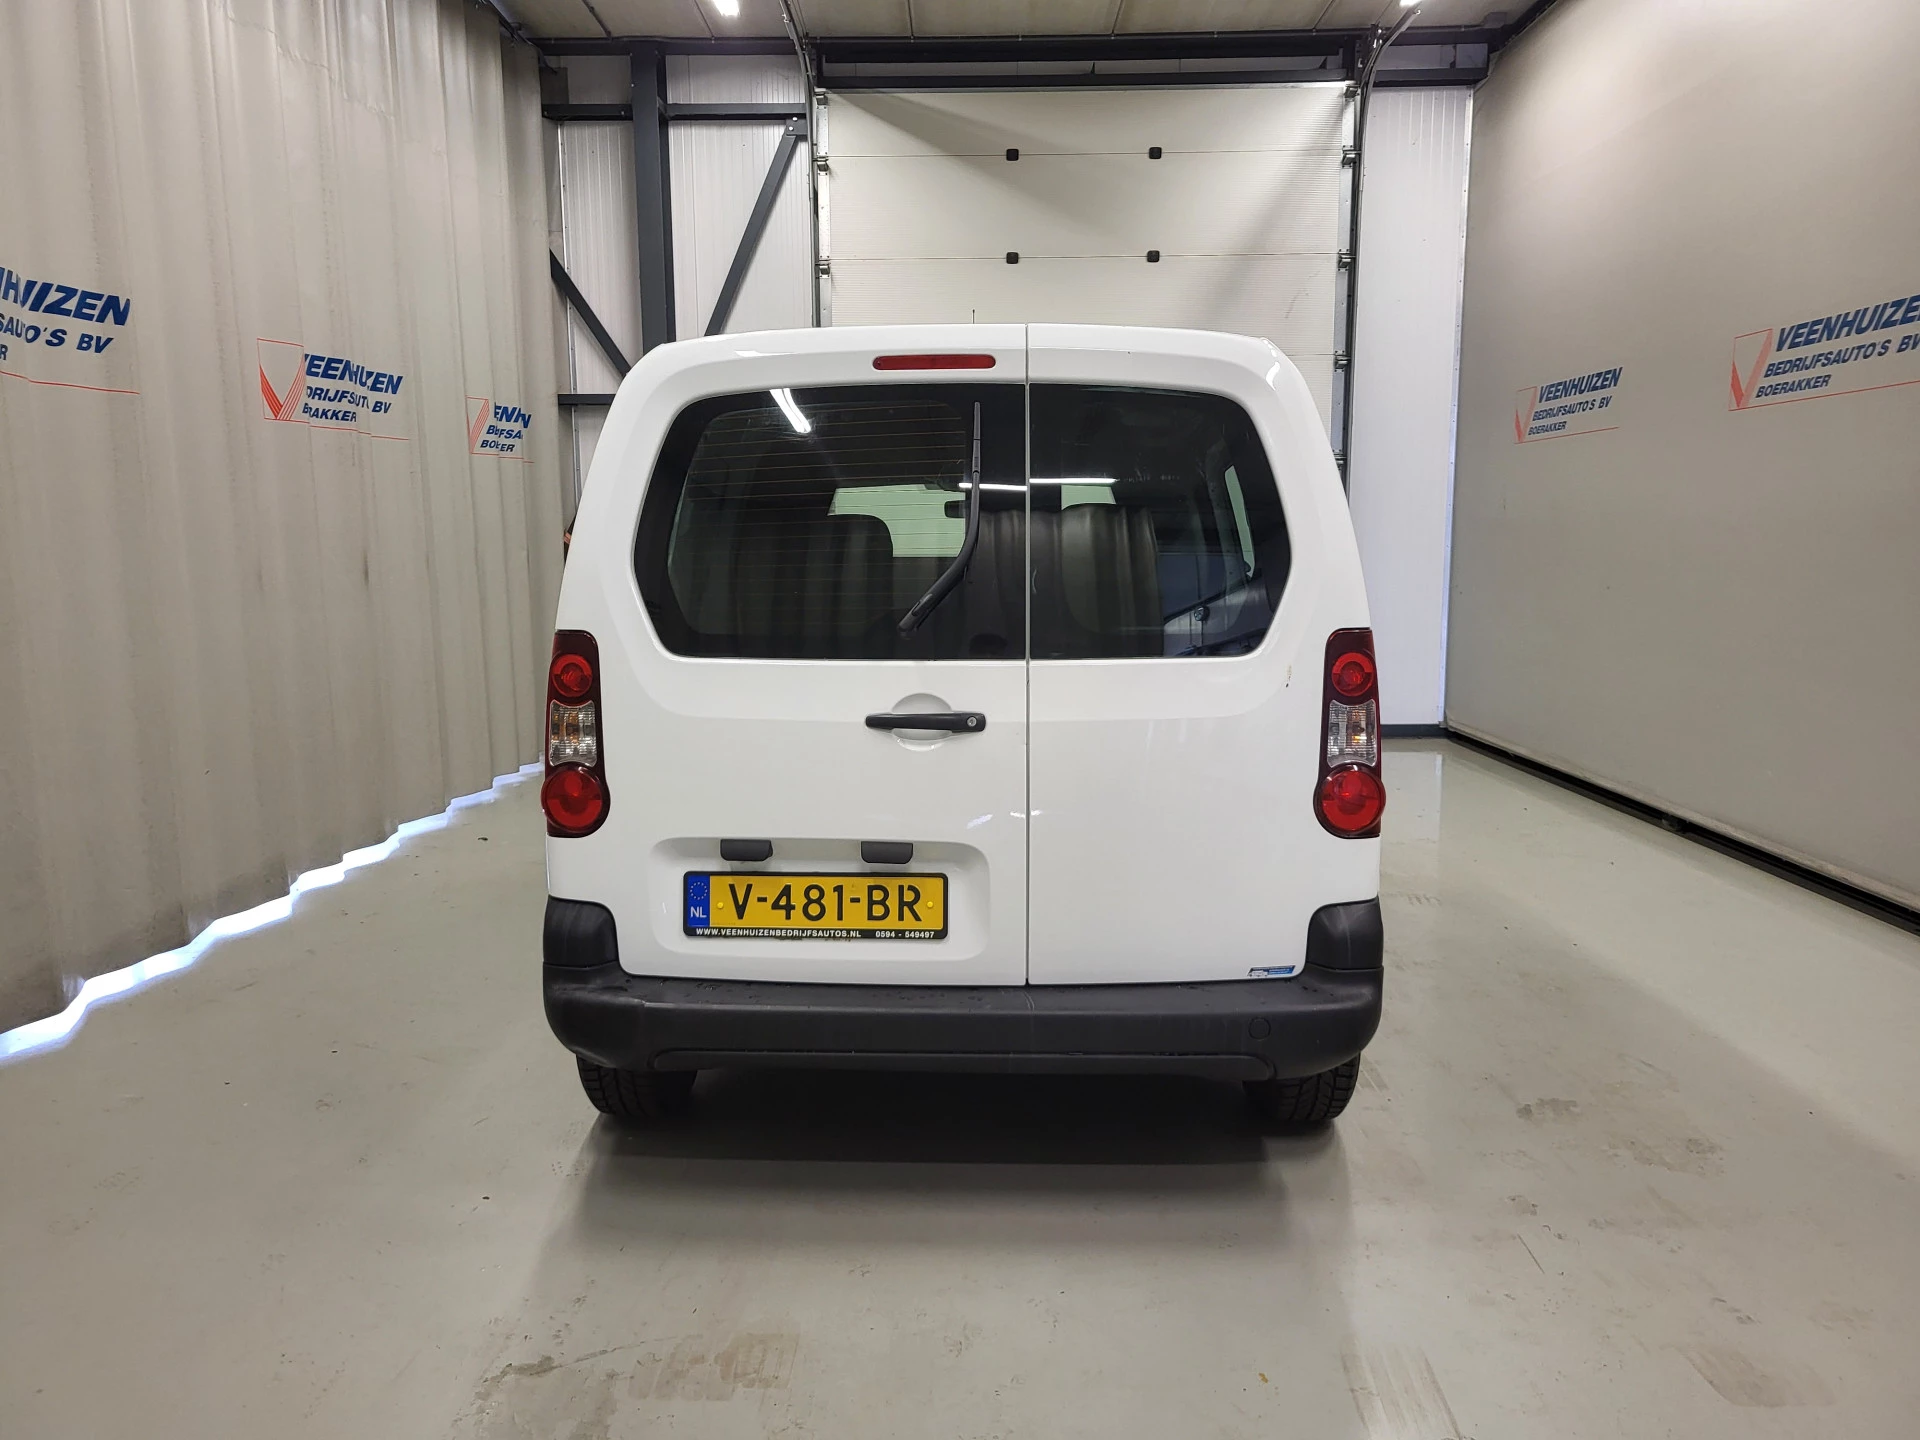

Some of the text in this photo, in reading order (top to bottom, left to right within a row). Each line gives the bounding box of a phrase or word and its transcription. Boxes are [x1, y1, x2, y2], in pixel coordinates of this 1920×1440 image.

[1776, 294, 1920, 352] VEENHUIZE
[76, 333, 114, 354] BV
[1764, 338, 1892, 378] BEDRIJFSAUTO'S
[1539, 367, 1623, 403] VEENHUIZEN
[1755, 374, 1832, 398] BOERAKKER
[371, 400, 392, 414] BV
[1598, 396, 1612, 409] BV
[1528, 421, 1567, 435] BOERAKKER
[690, 906, 707, 919] NL
[728, 883, 922, 922] V-481-BR
[696, 928, 862, 938] WWW.VEENHUIZENBEDRIJFSAUTOS.NL
[875, 930, 896, 938] 0594
[904, 930, 935, 938] 549497
